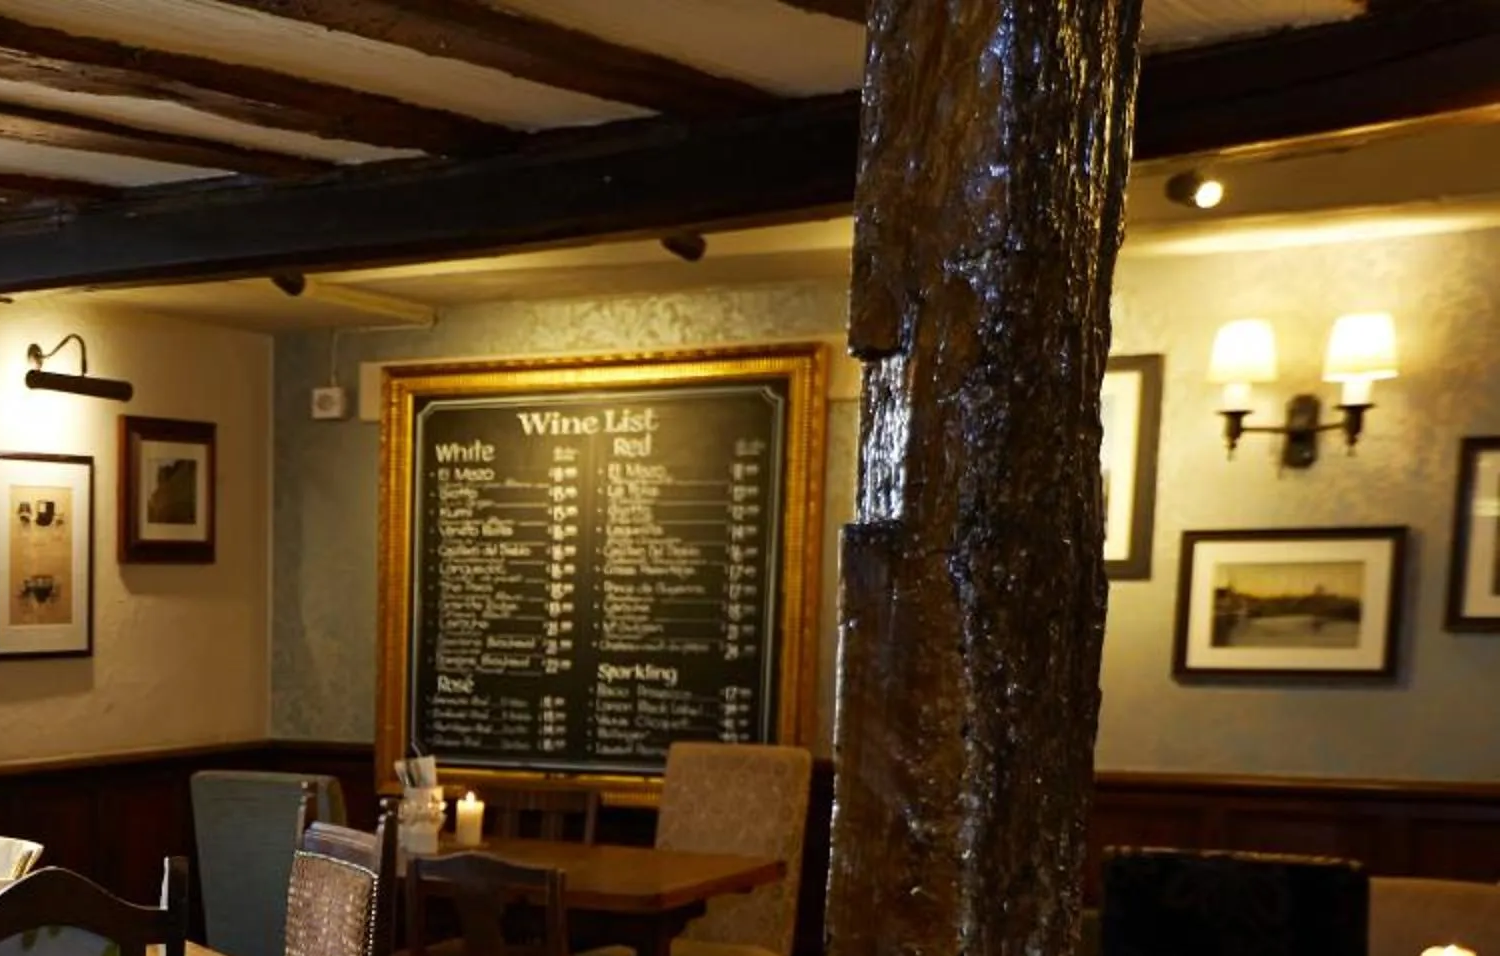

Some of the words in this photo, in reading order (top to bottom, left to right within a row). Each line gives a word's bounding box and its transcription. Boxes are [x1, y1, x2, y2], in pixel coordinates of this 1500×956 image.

[516, 411, 599, 436] Wine
[603, 407, 660, 433] List
[435, 439, 495, 463] White
[613, 433, 652, 458] Red
[437, 673, 475, 694] Rosé
[597, 662, 678, 687] Sparkling
